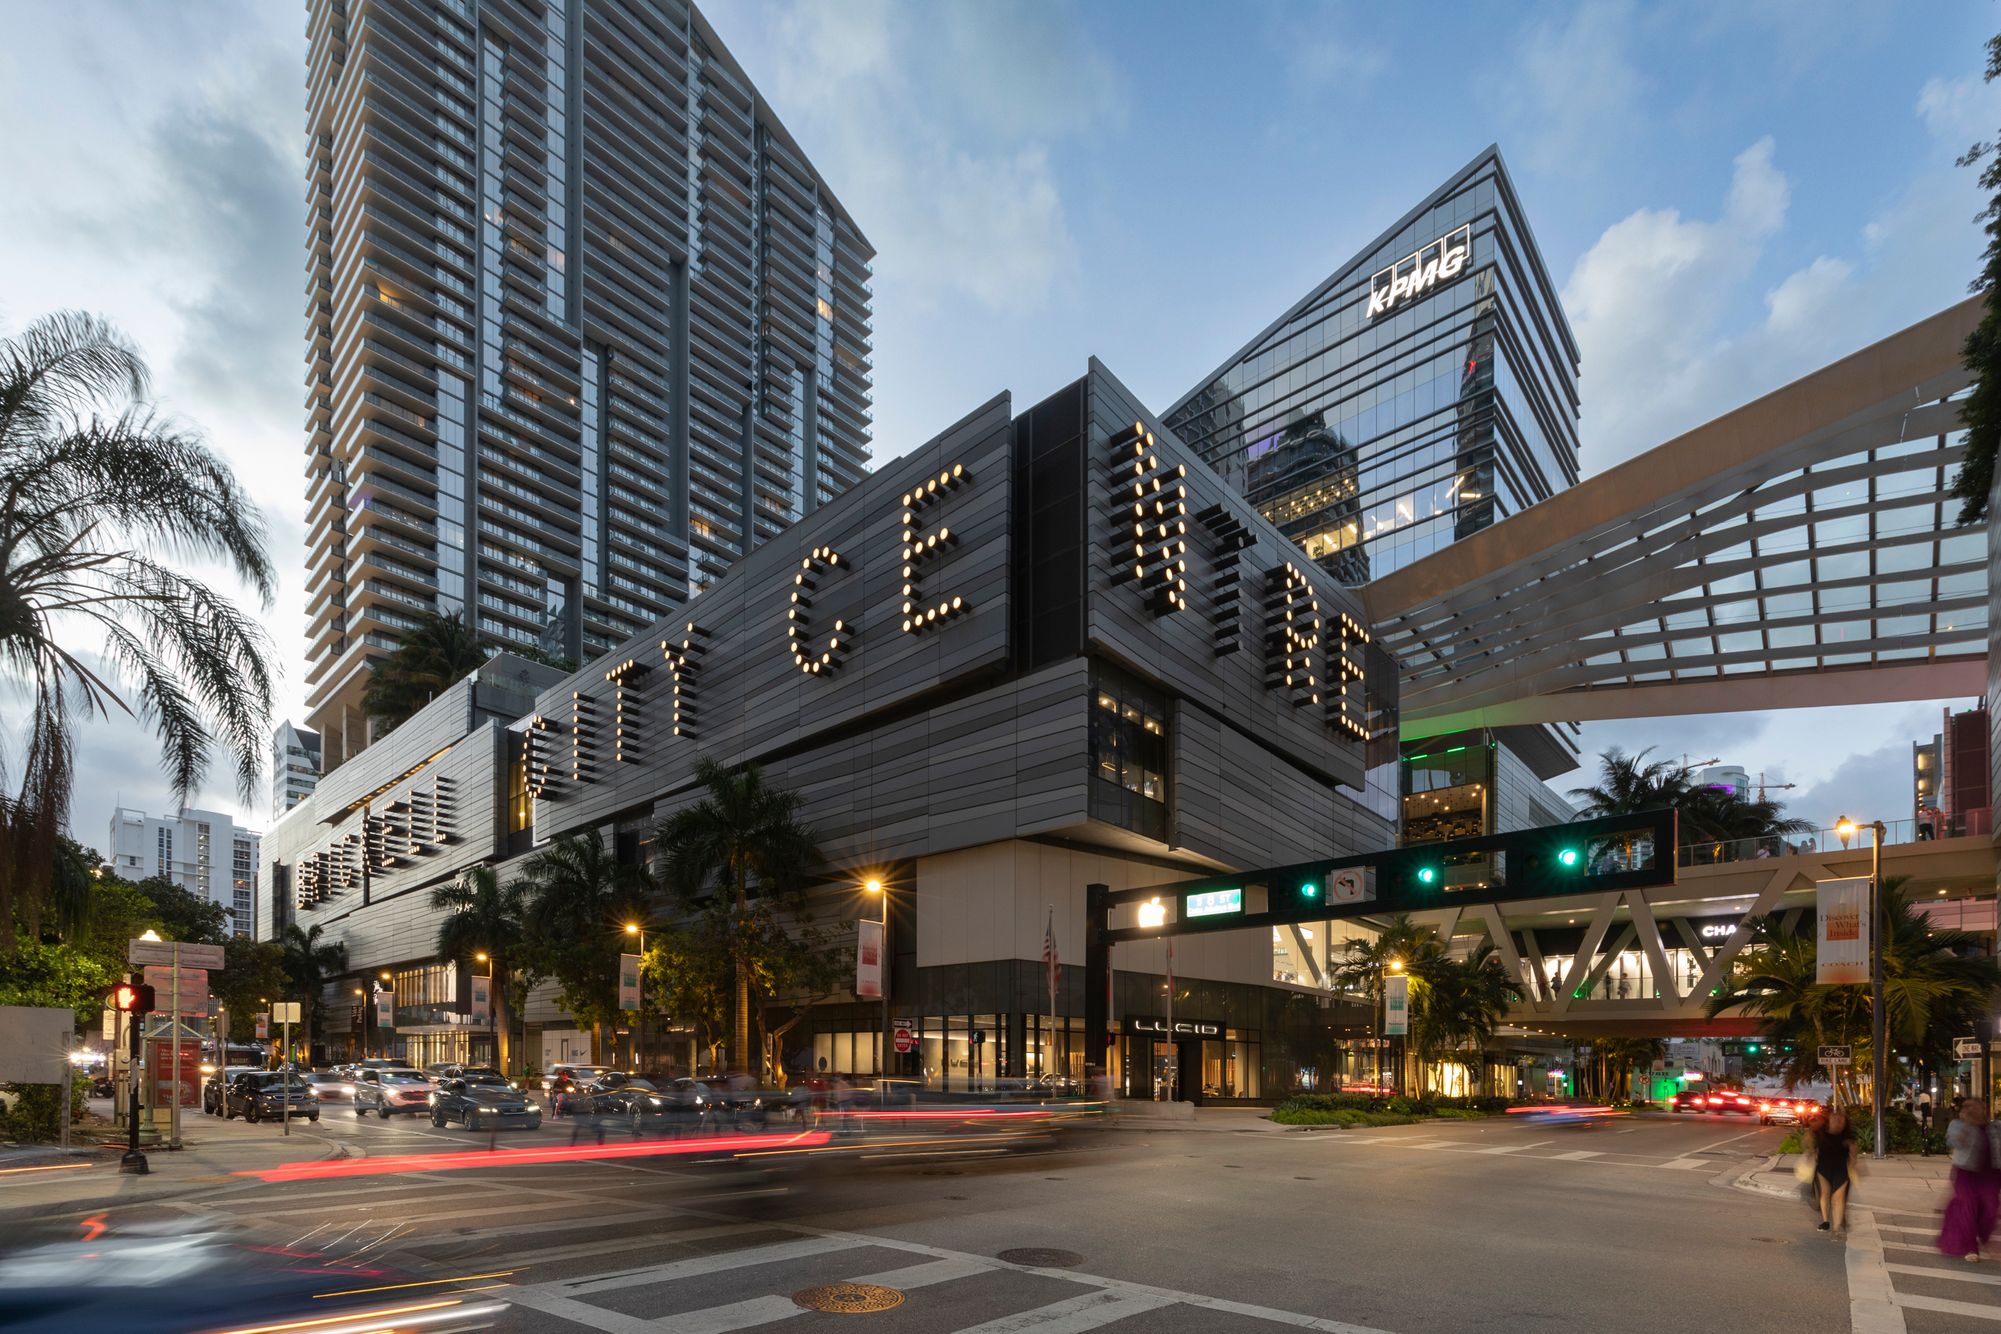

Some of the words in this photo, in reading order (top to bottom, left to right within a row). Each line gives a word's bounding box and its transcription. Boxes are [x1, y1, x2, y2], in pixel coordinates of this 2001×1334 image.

[1366, 245, 1466, 319] KPMG
[521, 621, 704, 799] CITY
[1207, 895, 1214, 906] 8
[1219, 893, 1231, 904] ST
[1820, 914, 1860, 922] Discover
[1835, 920, 1867, 929] What's
[1829, 929, 1857, 938] Inside
[1135, 1019, 1218, 1035] LUCID
